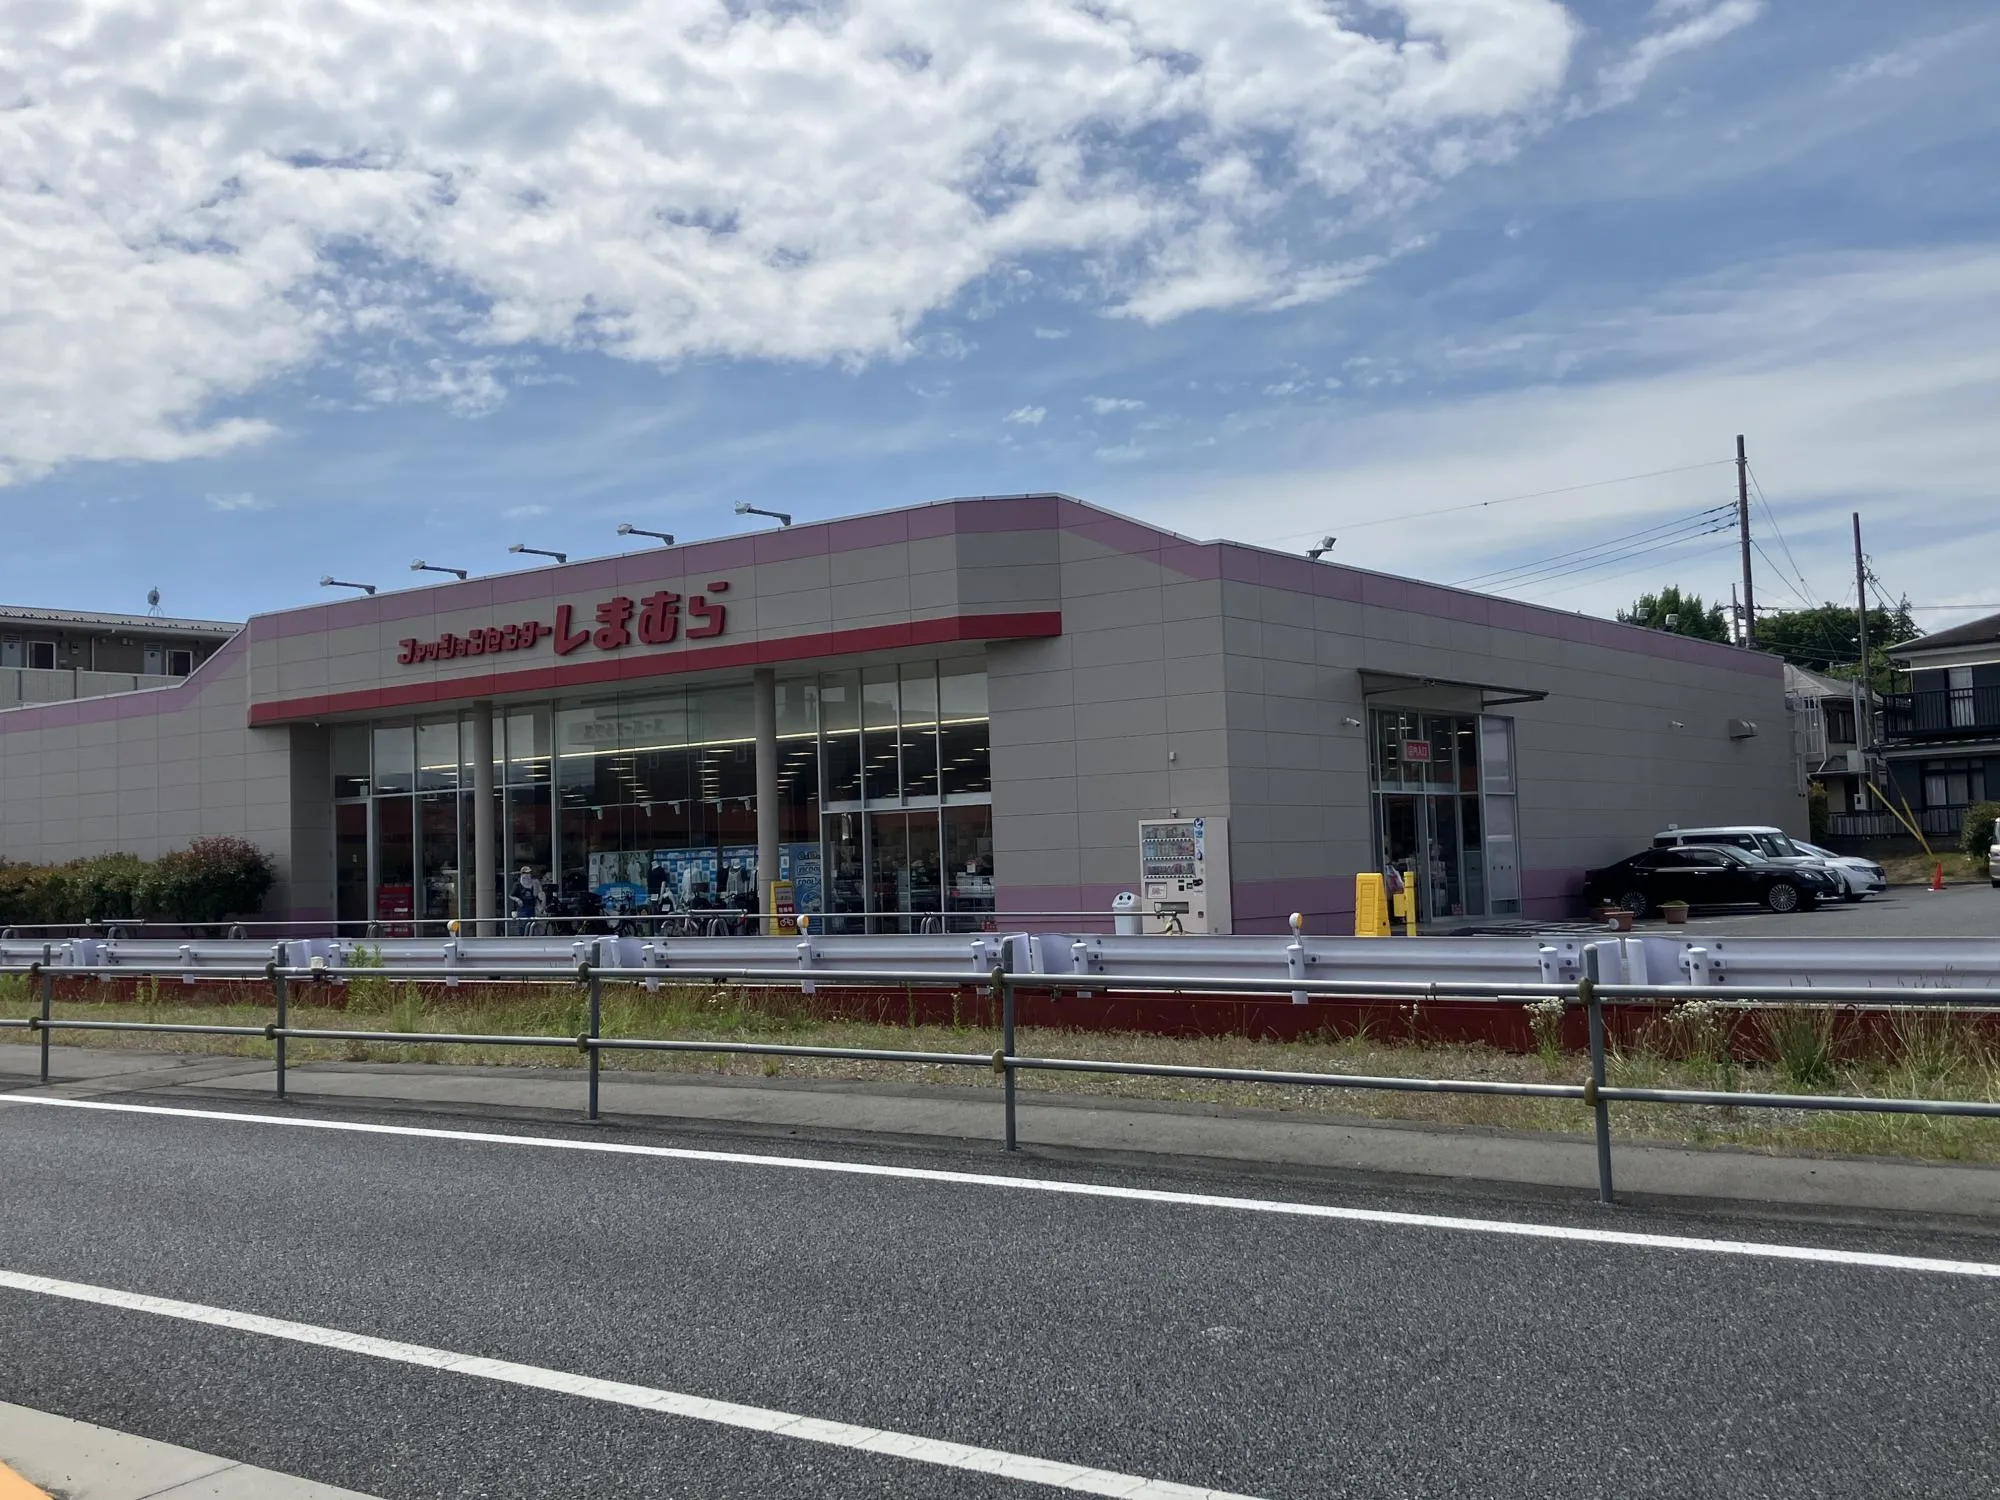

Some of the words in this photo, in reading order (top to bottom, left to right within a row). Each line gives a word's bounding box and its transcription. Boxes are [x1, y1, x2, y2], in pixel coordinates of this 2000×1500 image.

[397, 621, 552, 664] ファッションセンター
[554, 581, 729, 655] しまむら
